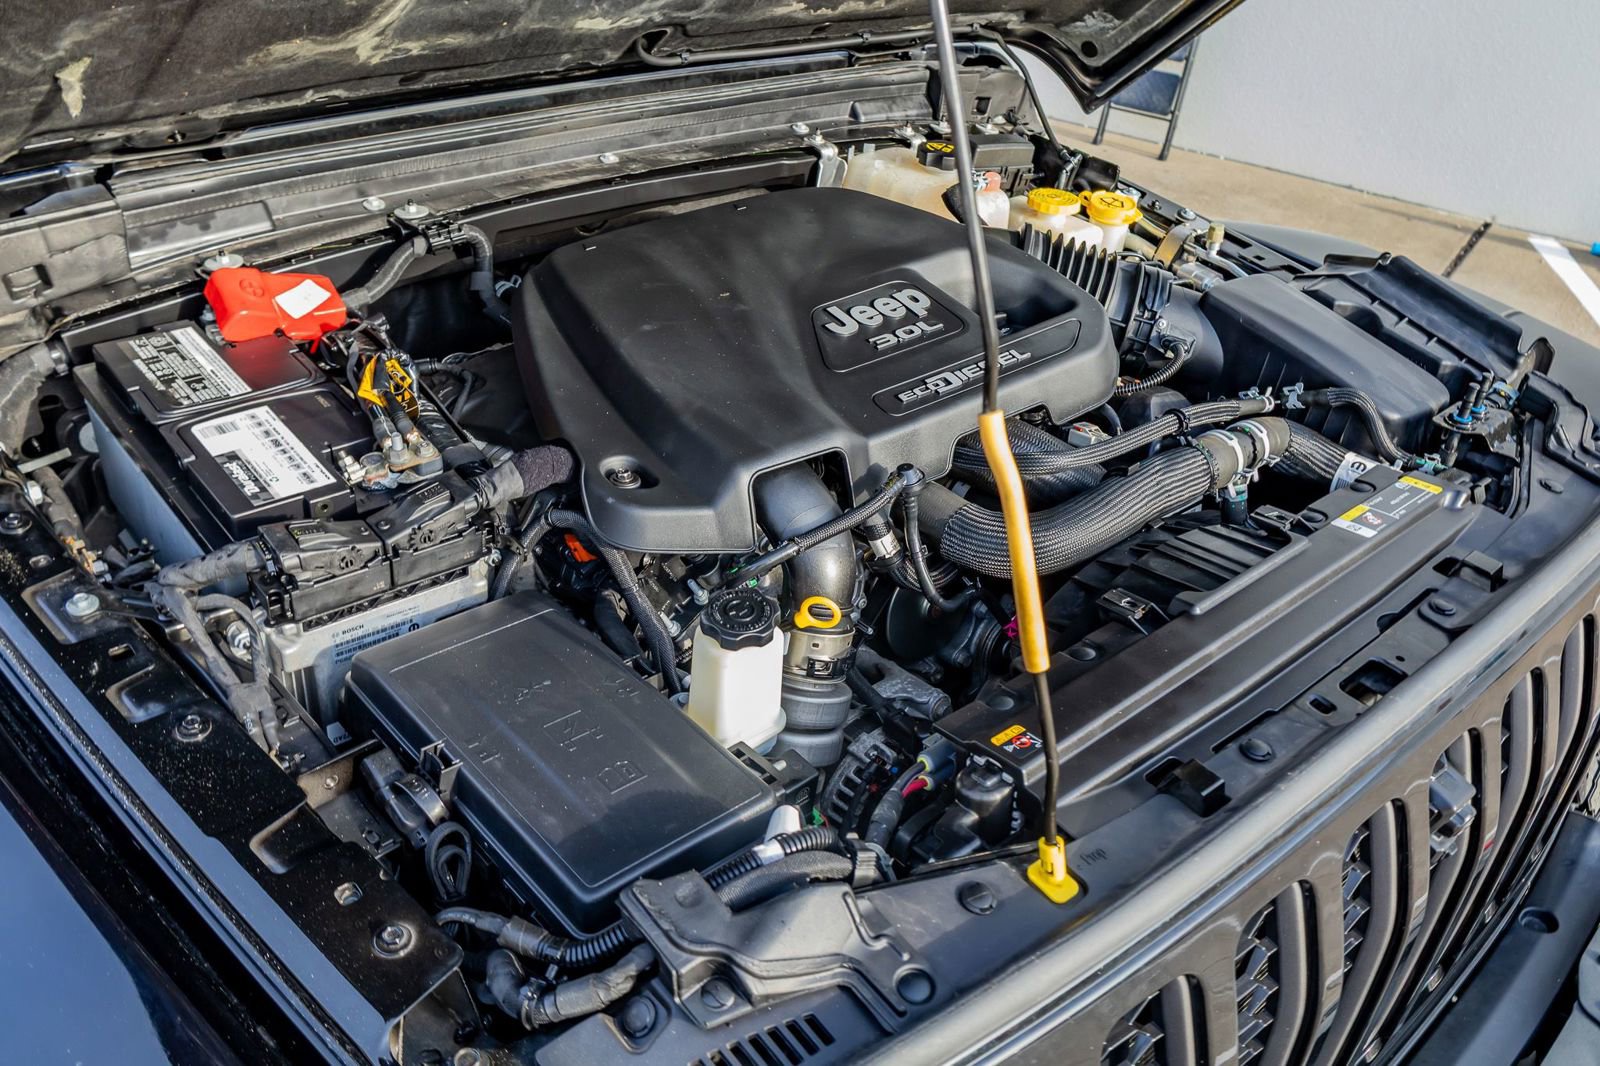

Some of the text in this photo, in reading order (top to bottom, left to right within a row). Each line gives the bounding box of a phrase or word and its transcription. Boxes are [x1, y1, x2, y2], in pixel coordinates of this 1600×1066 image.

[825, 289, 931, 336] Jeep
[868, 322, 944, 351] 3.0L
[341, 624, 365, 636] BOSCH
